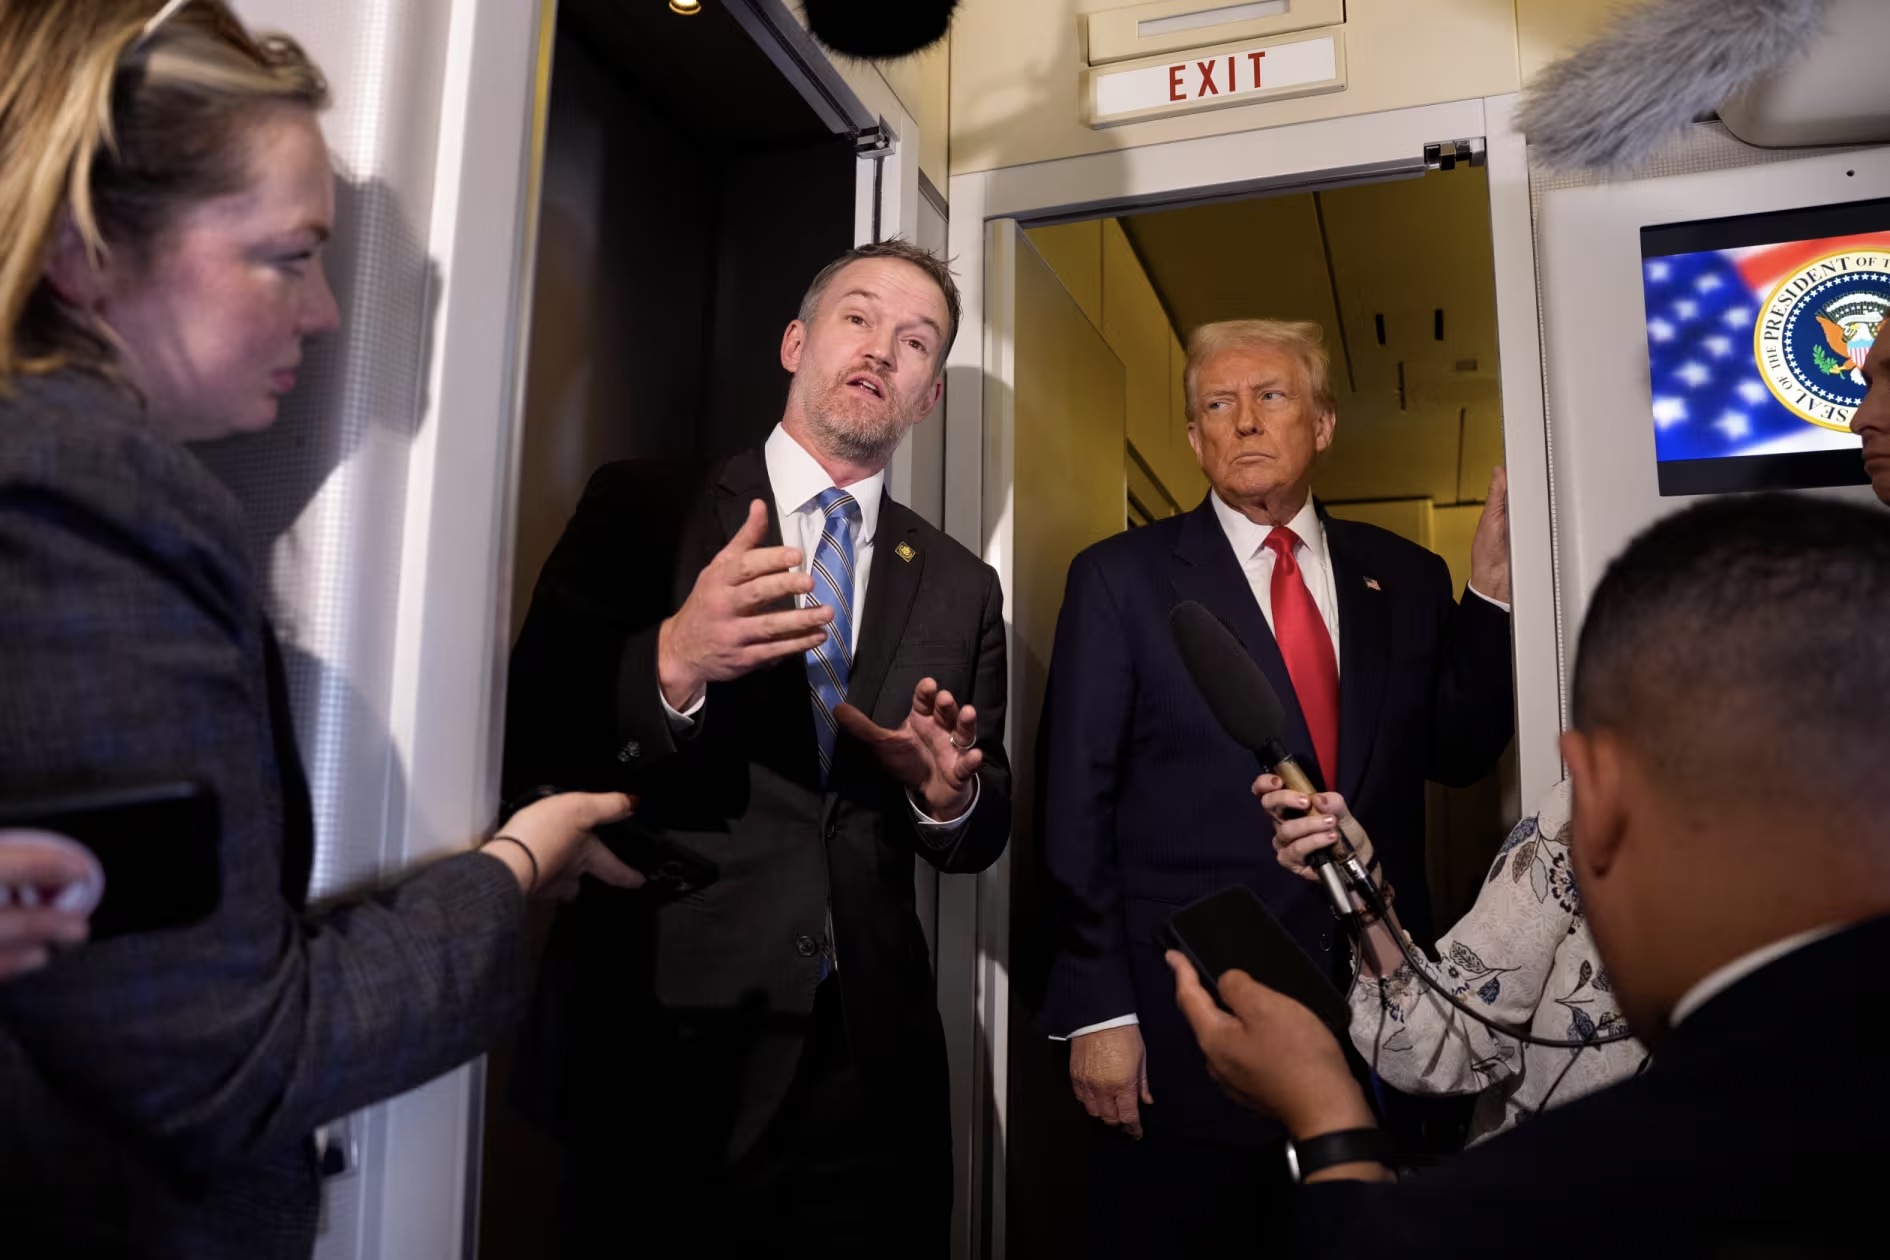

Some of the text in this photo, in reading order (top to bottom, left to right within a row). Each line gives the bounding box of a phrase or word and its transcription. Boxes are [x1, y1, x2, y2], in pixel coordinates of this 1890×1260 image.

[1169, 51, 1266, 102] EXIT
[1763, 256, 1878, 423] SEAL OF THE PRESIDENT OF
